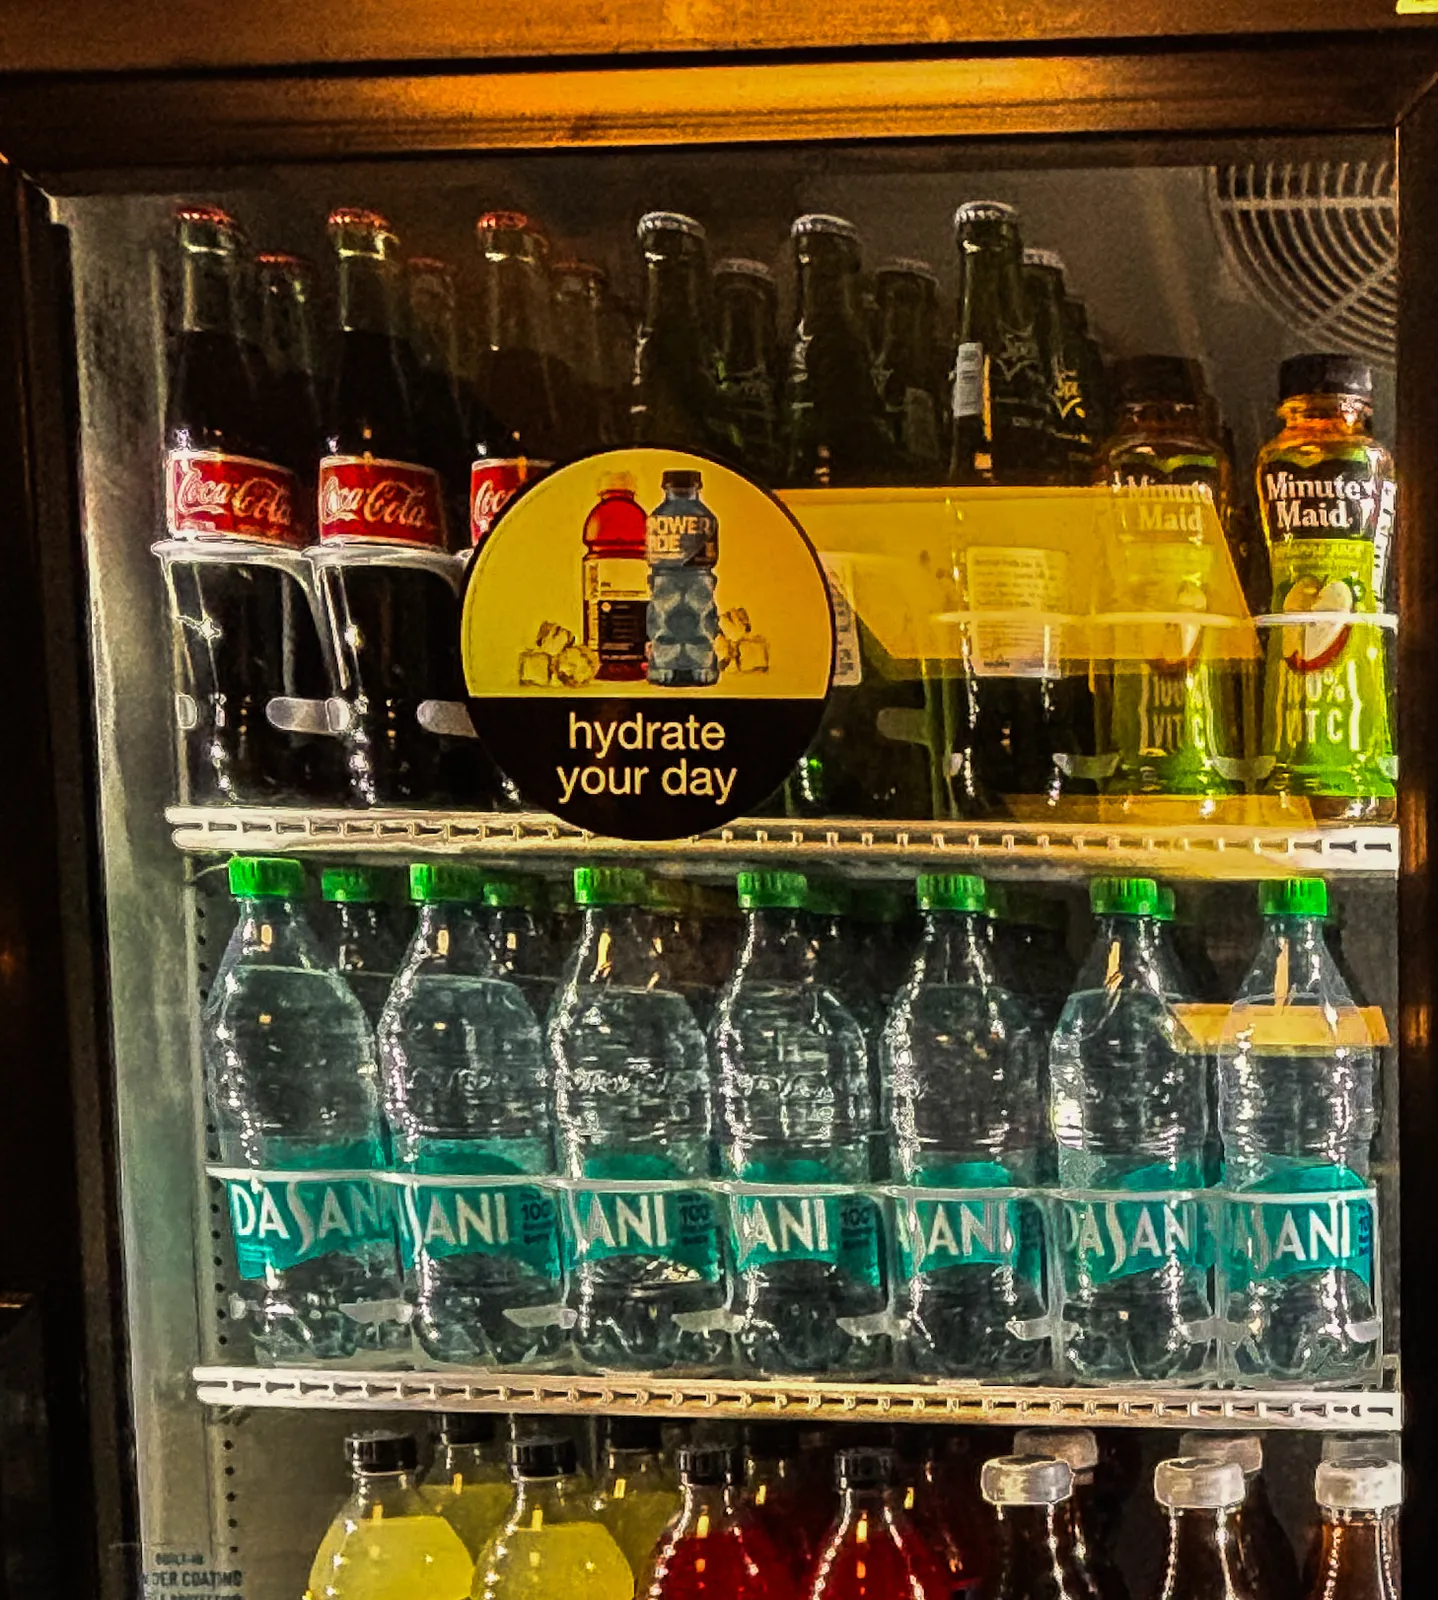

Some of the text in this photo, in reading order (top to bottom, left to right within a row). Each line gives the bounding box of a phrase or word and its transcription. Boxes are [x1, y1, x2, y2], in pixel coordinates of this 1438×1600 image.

[1267, 471, 1362, 500] Minute
[1276, 500, 1348, 529] Maid
[569, 712, 726, 759] hydrate
[556, 759, 738, 805] your day
